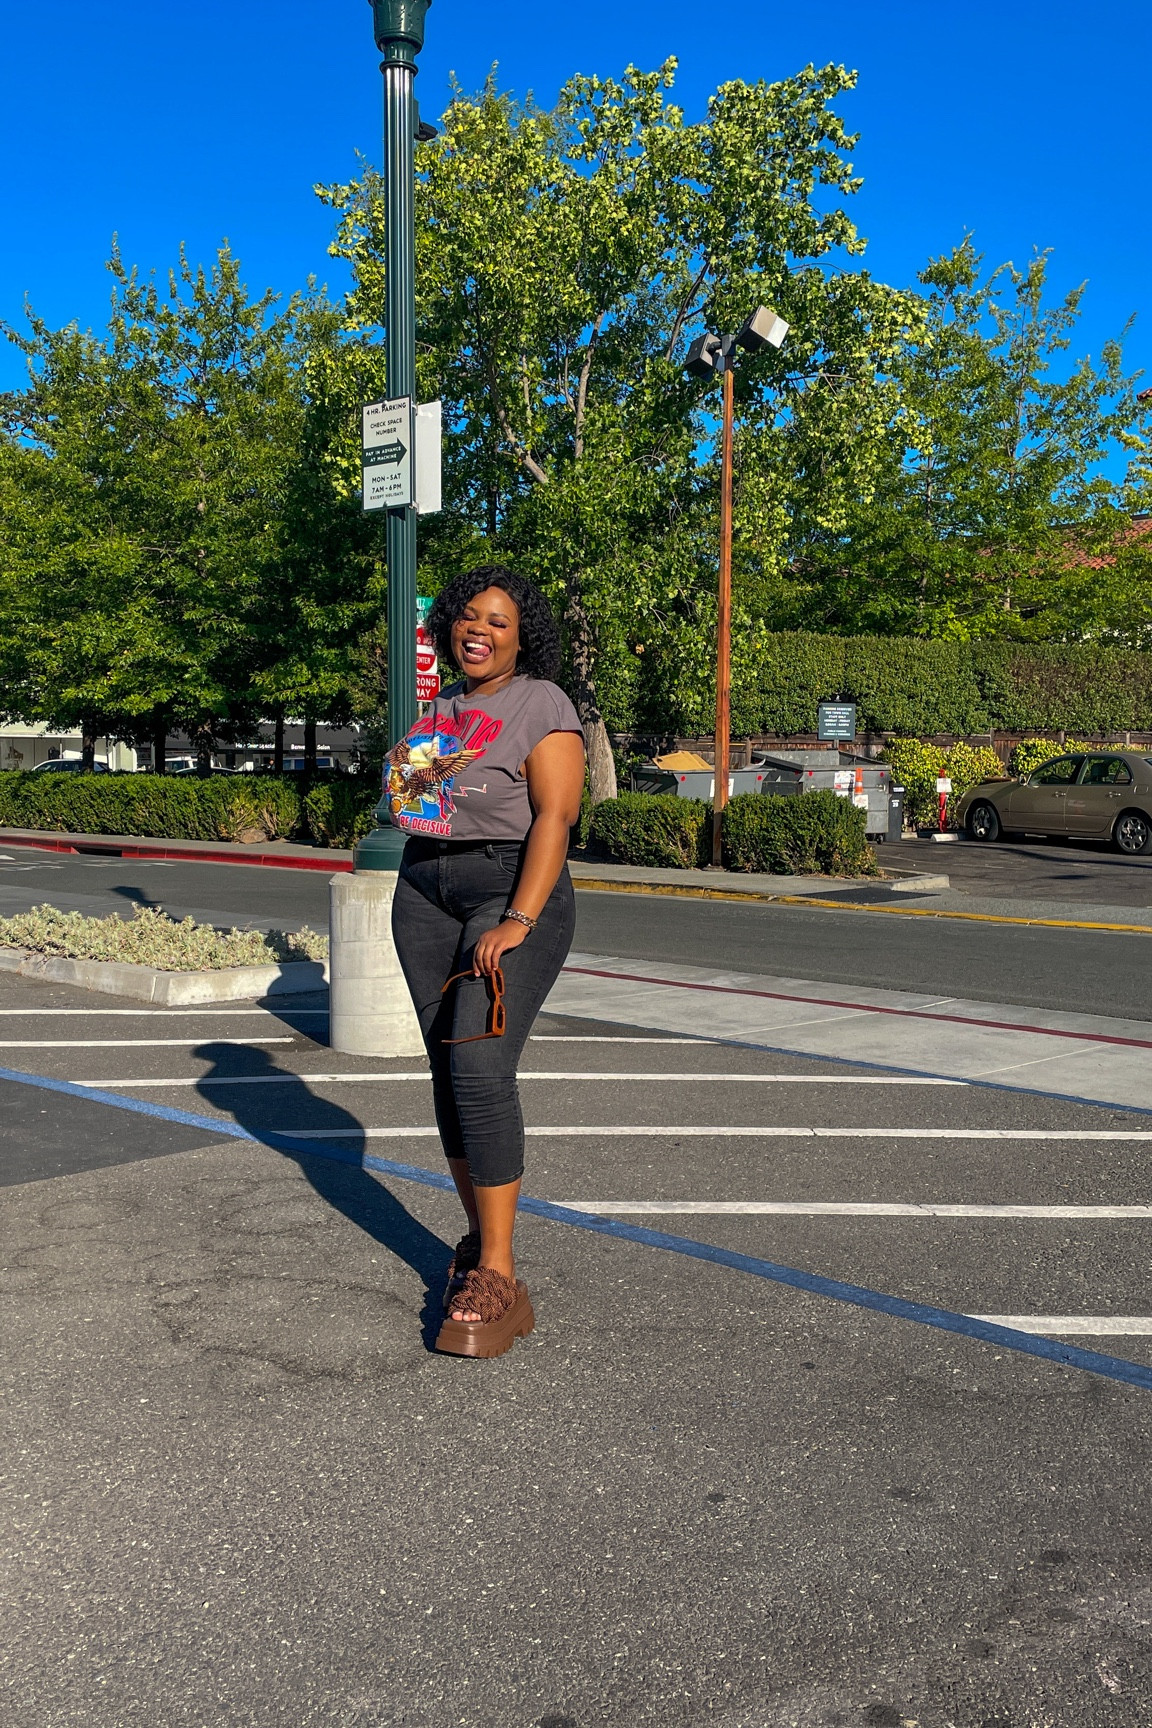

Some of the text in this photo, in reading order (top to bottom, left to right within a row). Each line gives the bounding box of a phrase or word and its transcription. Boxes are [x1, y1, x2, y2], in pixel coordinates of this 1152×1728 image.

[382, 402, 406, 412] PARKING
[370, 418, 402, 429] CHECK SPACE
[376, 428, 396, 436] NUMBER
[382, 446, 401, 454] ADVANCE
[416, 656, 430, 664] ENTER
[416, 677, 436, 687] RONG
[400, 815, 452, 836] BE DECISIVE
